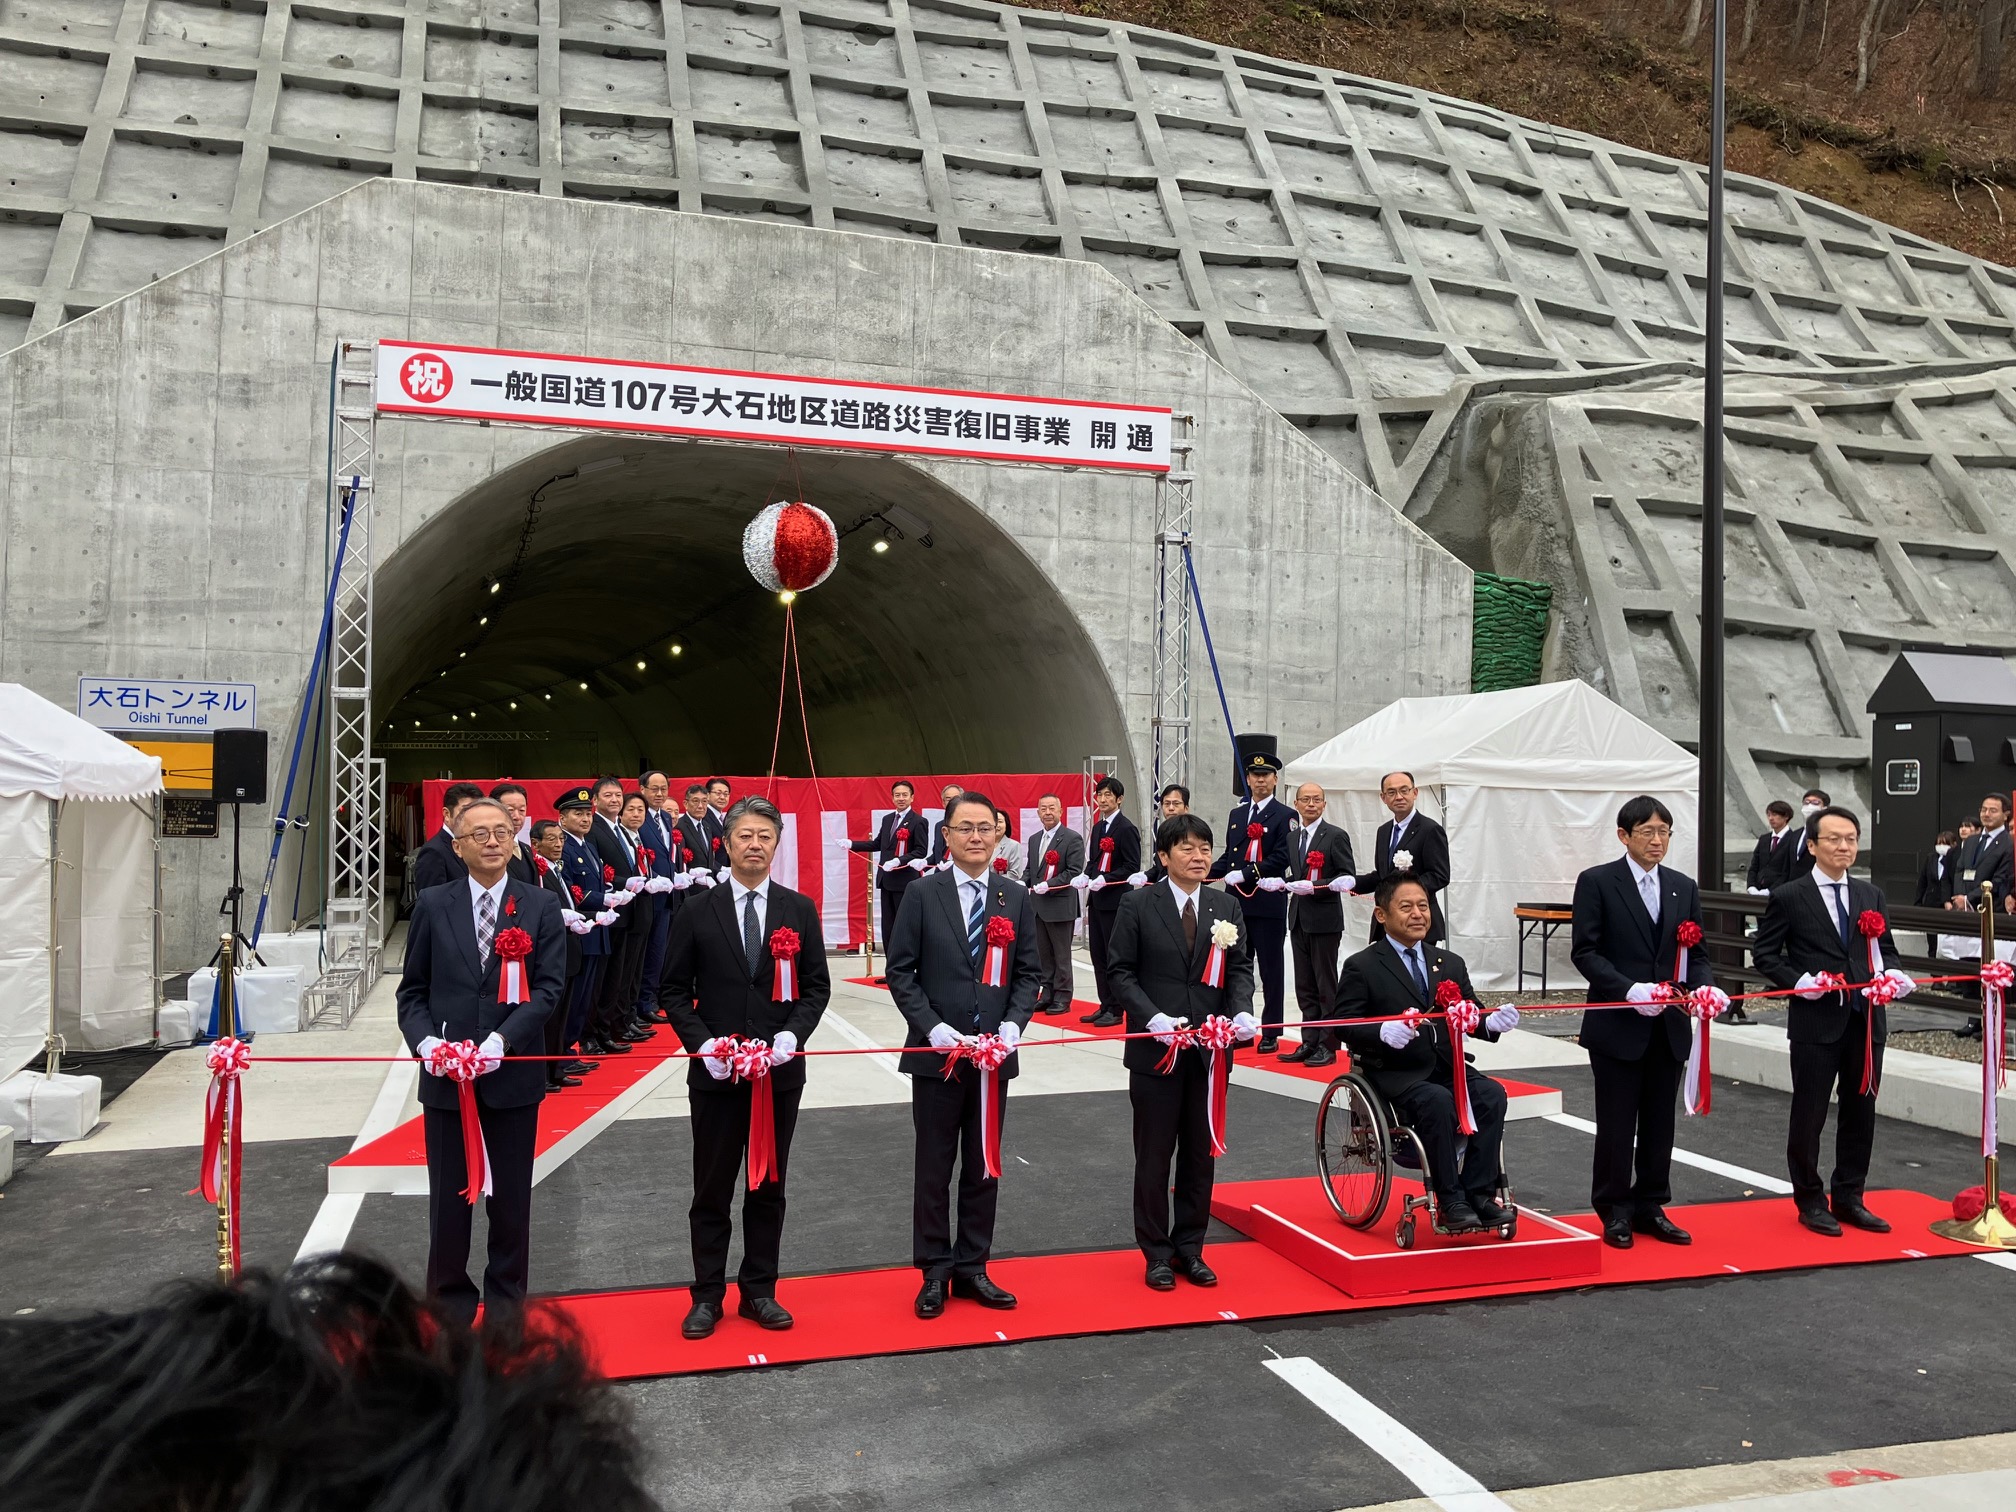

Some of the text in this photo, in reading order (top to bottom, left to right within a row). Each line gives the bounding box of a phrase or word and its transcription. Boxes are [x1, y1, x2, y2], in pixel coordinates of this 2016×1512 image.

[407, 359, 444, 397] 祝
[470, 369, 1071, 447] 一般国道107号大石地区道路災害復旧事業
[88, 686, 247, 712] 大石トンネル
[128, 711, 208, 725] Oishi Tunnel
